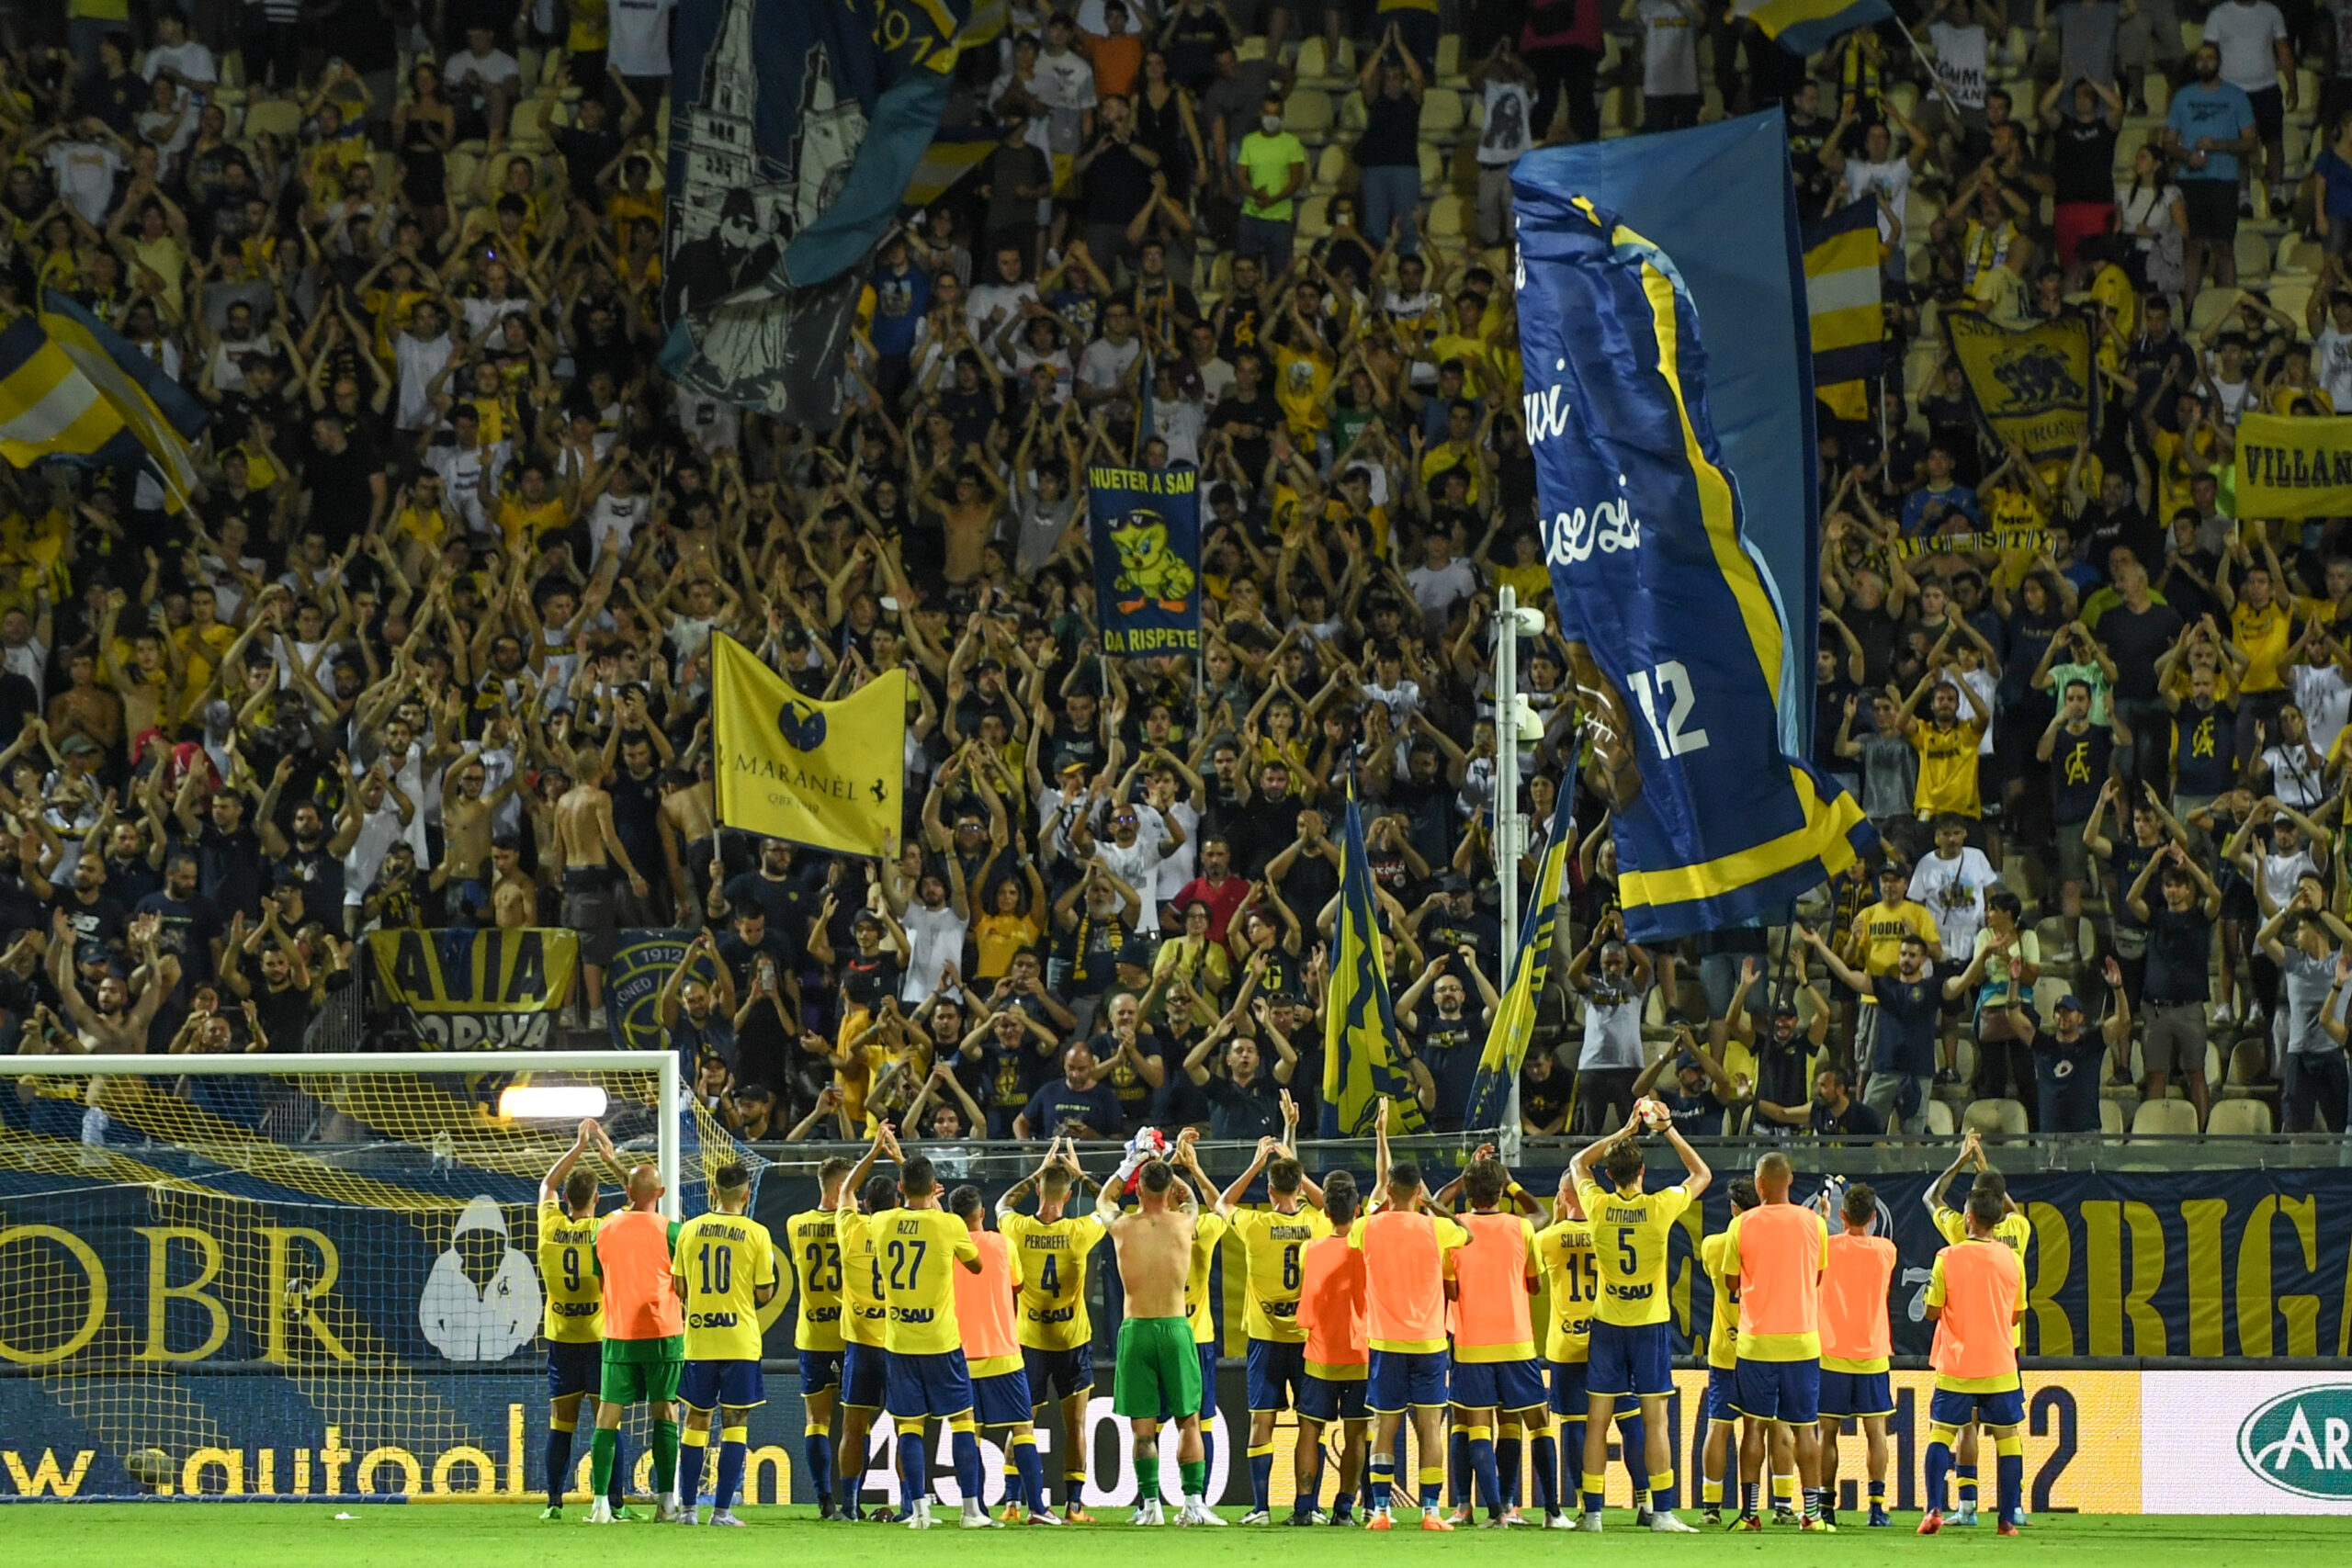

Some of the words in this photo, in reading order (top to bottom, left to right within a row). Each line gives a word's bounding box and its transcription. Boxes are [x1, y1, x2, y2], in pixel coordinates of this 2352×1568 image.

[1090, 468, 1148, 492] NUETER
[1152, 473, 1162, 494] A
[1166, 471, 1195, 495] SAN
[1104, 629, 1125, 652] DA
[1128, 627, 1198, 651] RISPETE
[1626, 660, 1710, 761] 12
[735, 752, 859, 802] MARANÈL
[641, 948, 684, 964] 1912
[897, 1220, 920, 1235] AZZI
[1270, 1224, 1312, 1240] MAGNINO
[1605, 1207, 1647, 1224] CITTADINI
[563, 1247, 581, 1292] 9
[698, 1243, 731, 1294] 10
[806, 1243, 842, 1292] 23
[888, 1240, 926, 1290] 27
[1283, 1245, 1300, 1290] 6
[1618, 1227, 1637, 1275] 5
[1041, 1254, 1061, 1298] 4
[1566, 1253, 1597, 1302] 15
[704, 1313, 738, 1327] SAU
[899, 1308, 934, 1323] SAU
[2275, 1402, 2352, 1470] AR
